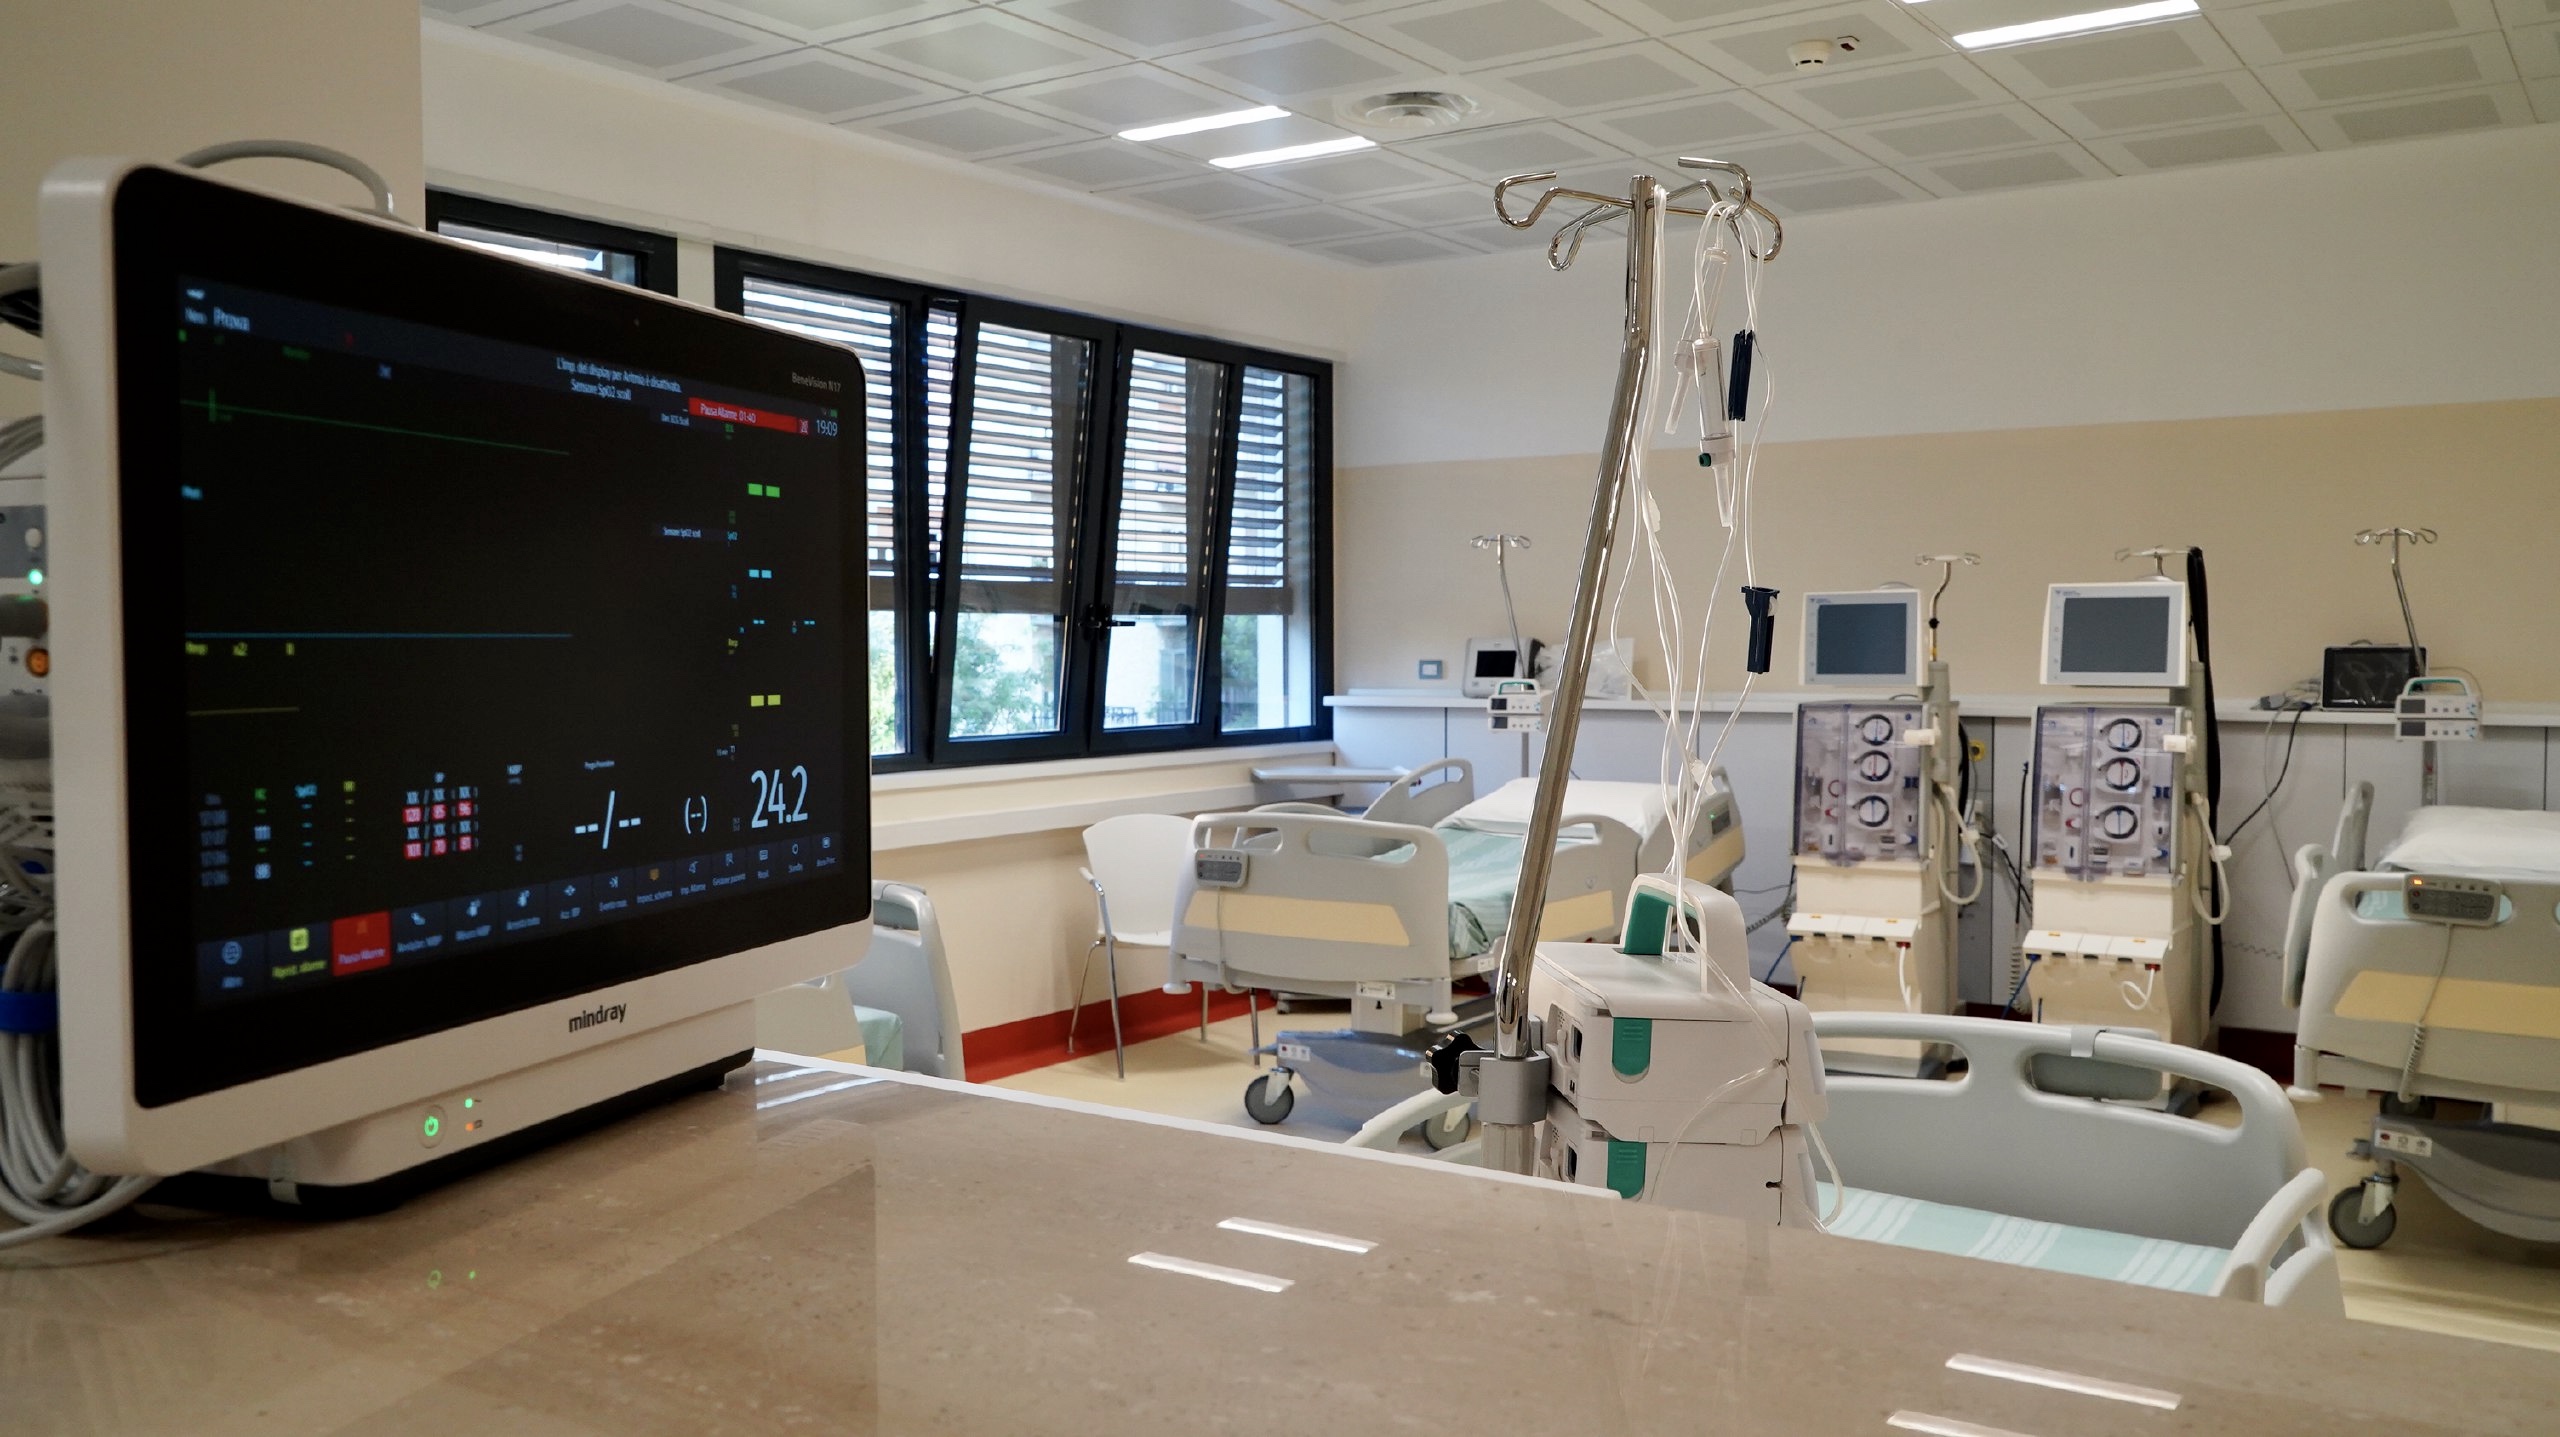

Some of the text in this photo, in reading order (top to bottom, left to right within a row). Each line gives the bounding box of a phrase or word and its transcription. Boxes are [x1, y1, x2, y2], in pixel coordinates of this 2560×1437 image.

[213, 305, 250, 333] Prova
[792, 371, 827, 390] BeneVision
[816, 419, 838, 437] 19:09
[751, 765, 808, 829] 24.2
[568, 1002, 627, 1033] mindray
